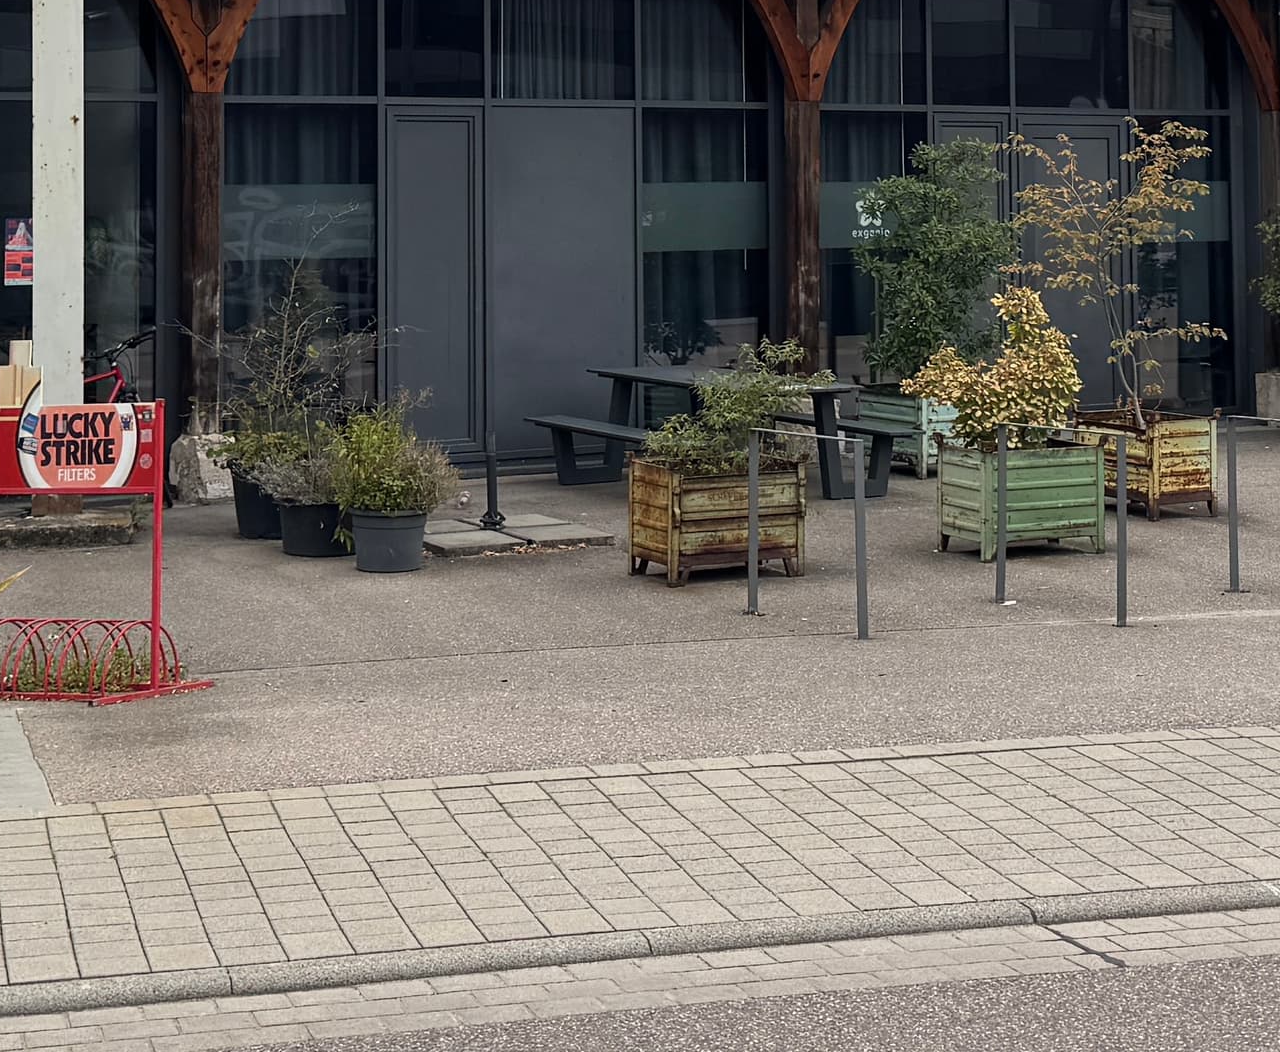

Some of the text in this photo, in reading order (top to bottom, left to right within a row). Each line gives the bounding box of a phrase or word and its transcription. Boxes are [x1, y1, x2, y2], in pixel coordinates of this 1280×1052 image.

[41, 412, 115, 439] LUCKY
[41, 439, 115, 466] STRIKE
[58, 468, 96, 481] FILTERS
